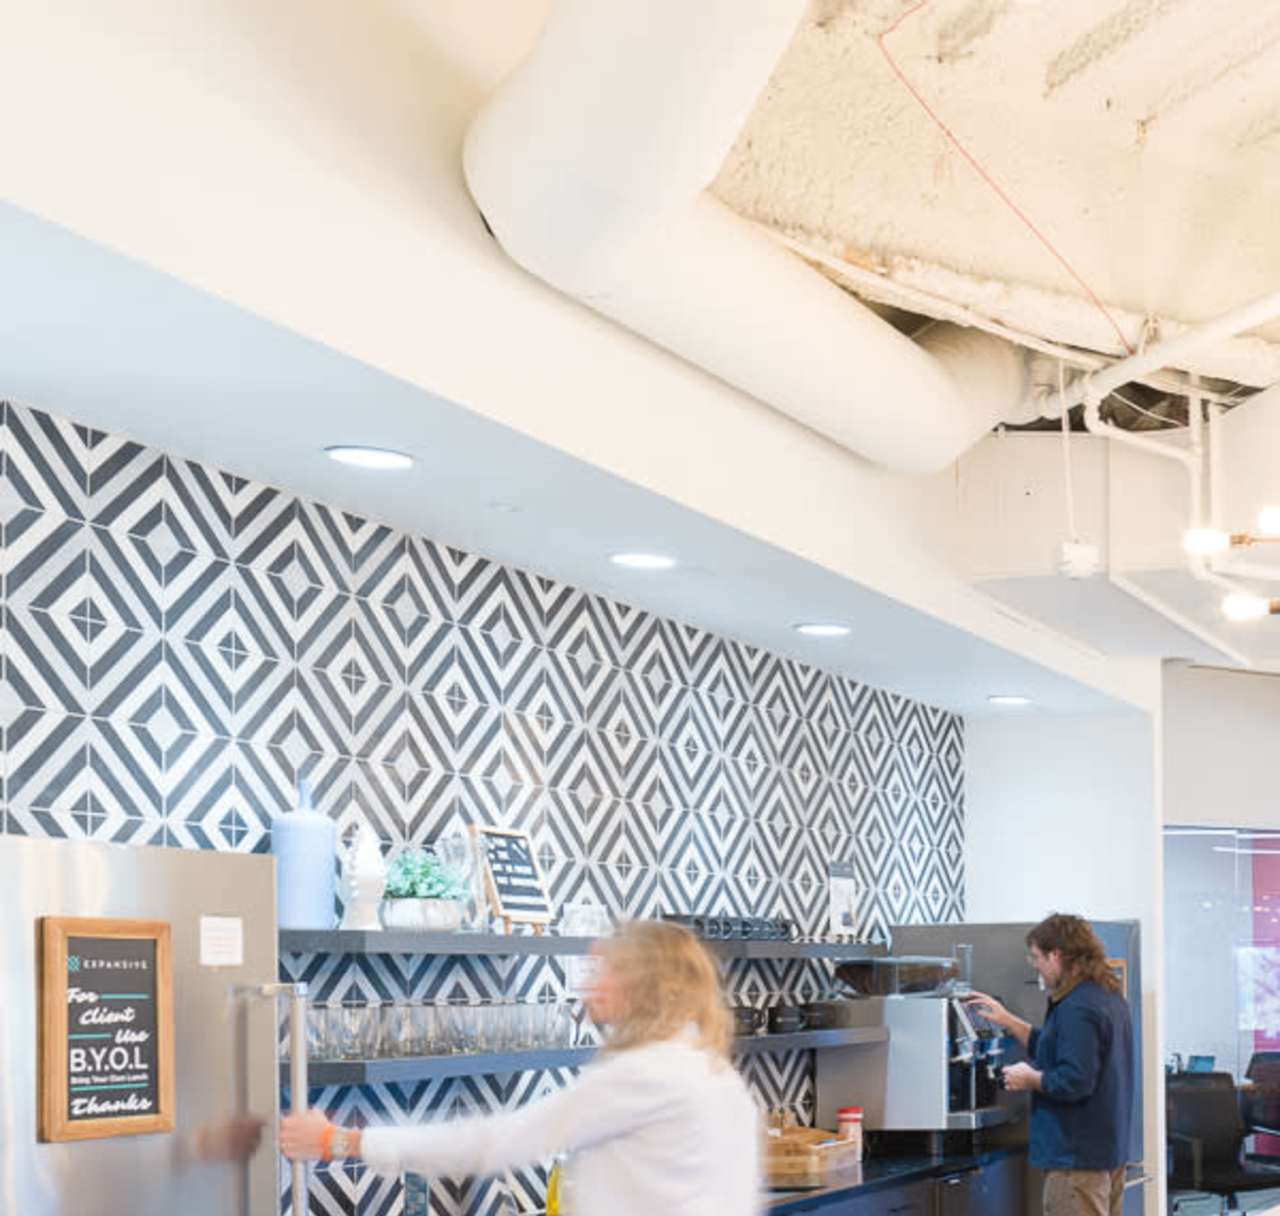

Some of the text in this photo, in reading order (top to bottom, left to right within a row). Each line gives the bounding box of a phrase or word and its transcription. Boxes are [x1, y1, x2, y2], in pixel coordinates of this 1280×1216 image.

[67, 987, 99, 1003] For
[79, 1006, 136, 1025] Client
[114, 1027, 150, 1044] Use
[70, 1093, 153, 1116] Thanks
